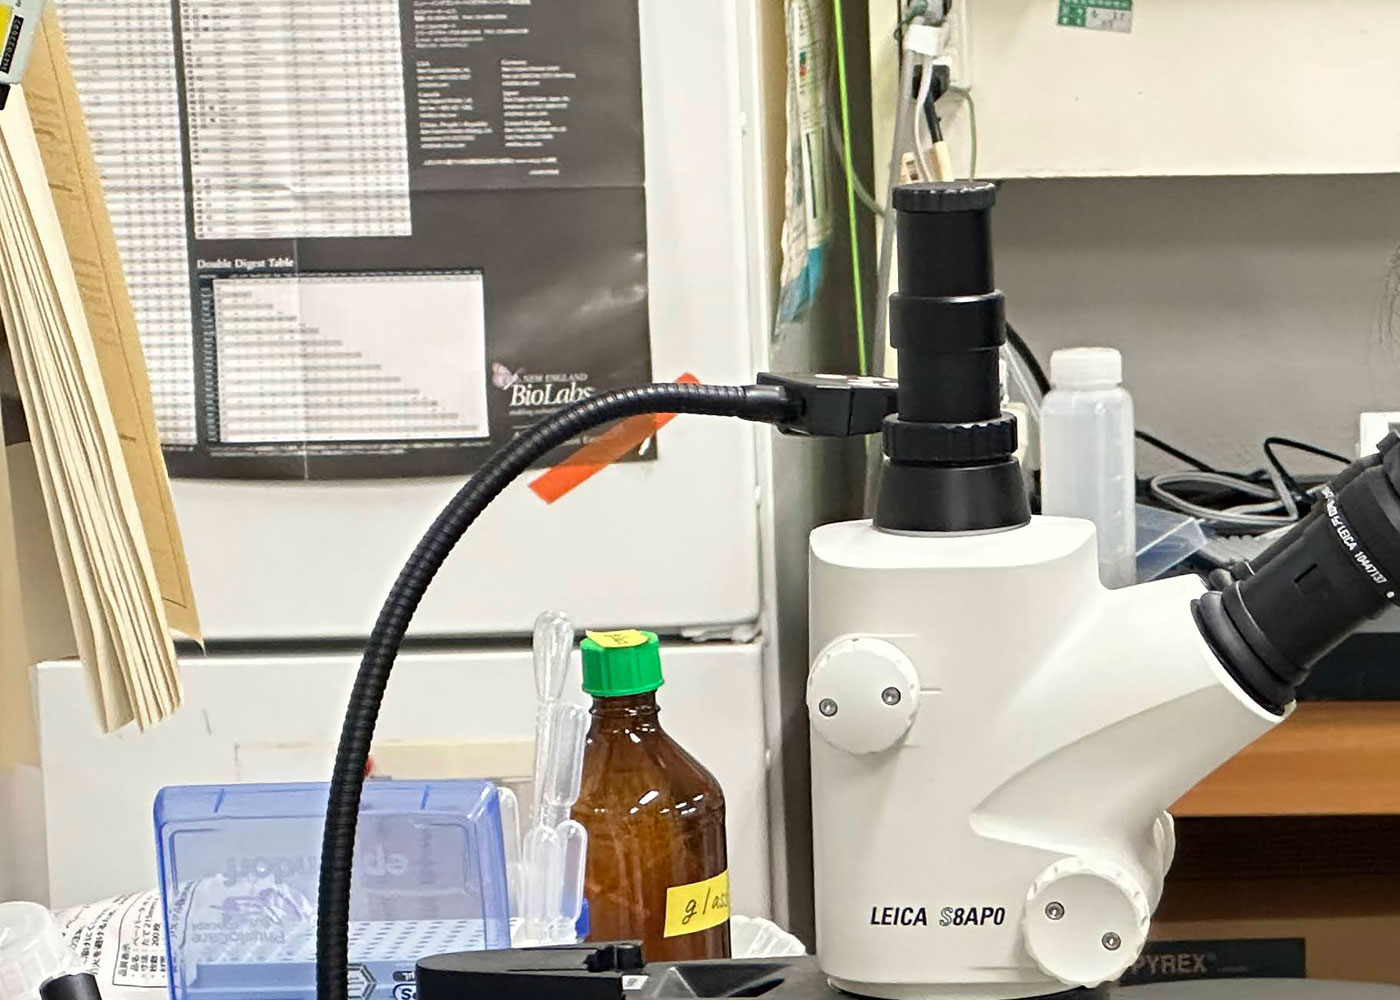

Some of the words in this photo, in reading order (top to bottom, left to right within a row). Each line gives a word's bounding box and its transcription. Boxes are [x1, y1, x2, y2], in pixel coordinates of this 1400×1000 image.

[196, 258, 233, 269] Double
[234, 258, 266, 271] Digest
[267, 257, 295, 268] Table
[522, 374, 544, 383] NEW
[545, 372, 588, 383] ENGLAND
[509, 381, 594, 407] BioLabs
[1336, 525, 1358, 551] LEICA
[1354, 551, 1388, 584] 10447137
[870, 906, 928, 927] LEICA
[1129, 953, 1208, 975] PYREX
